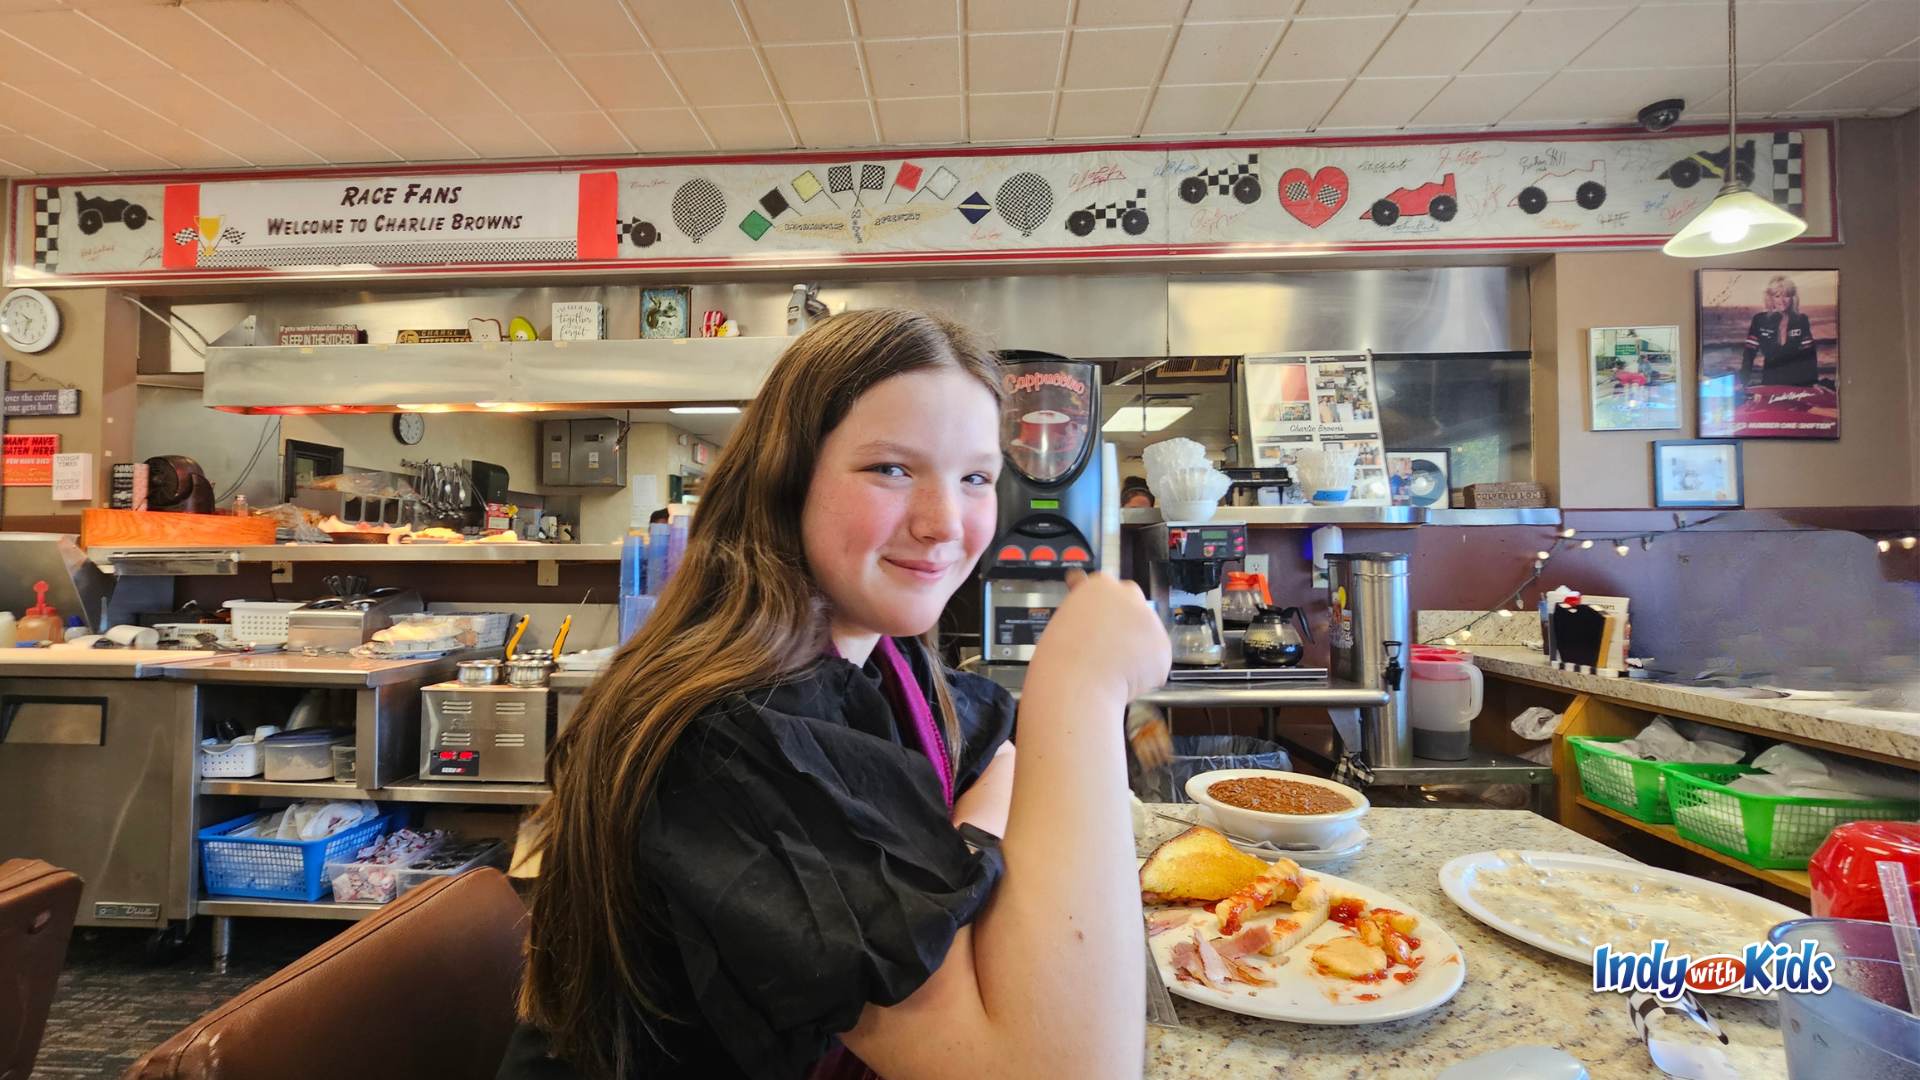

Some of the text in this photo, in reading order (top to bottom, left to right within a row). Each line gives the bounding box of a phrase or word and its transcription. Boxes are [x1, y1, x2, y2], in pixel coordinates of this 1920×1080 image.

[340, 184, 463, 207] RACE FANS
[267, 213, 523, 235] WELCOME TO CHARLIE BROWNS
[281, 333, 354, 345] SLEEP IN THE KITCHEN
[1004, 372, 1085, 394] Cappuccino
[5, 391, 57, 402] over the coffee
[21, 405, 36, 414] gets
[36, 402, 53, 411] hurt
[4, 437, 55, 446] MANY HAVE
[32, 447, 55, 456] HERE
